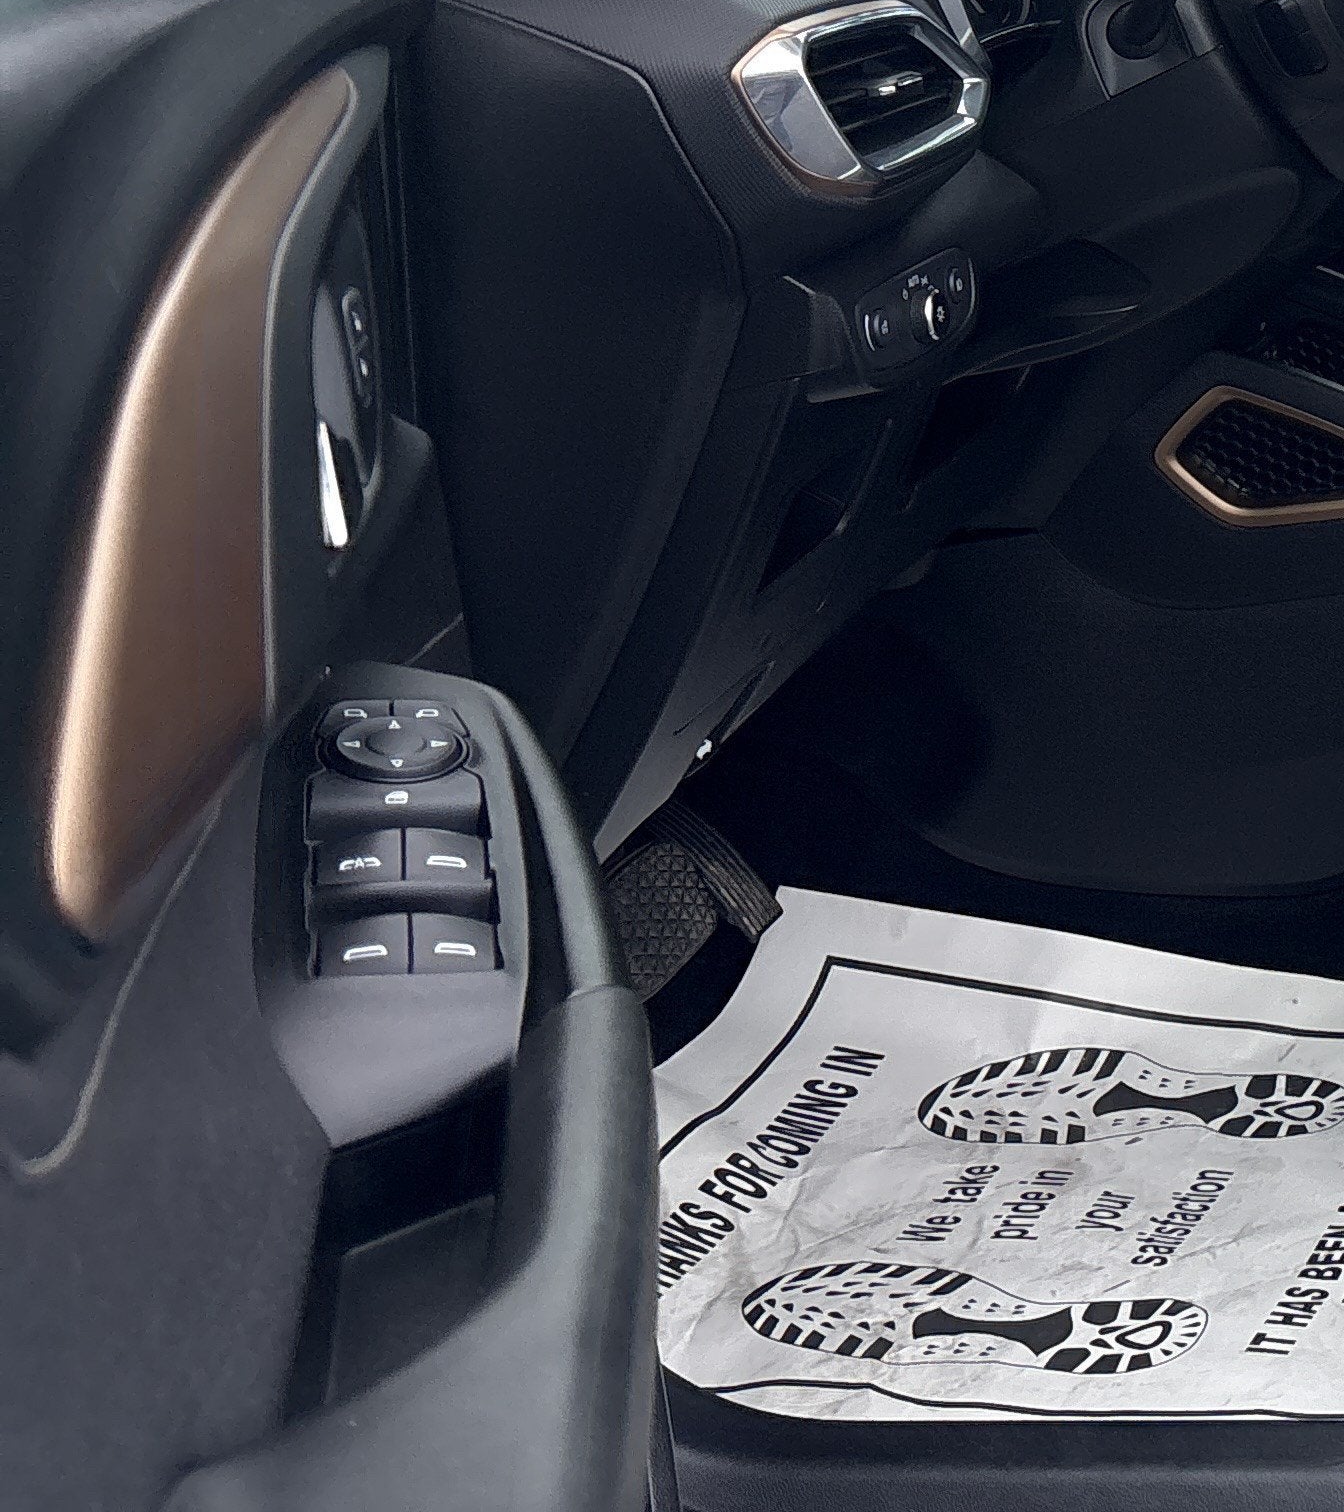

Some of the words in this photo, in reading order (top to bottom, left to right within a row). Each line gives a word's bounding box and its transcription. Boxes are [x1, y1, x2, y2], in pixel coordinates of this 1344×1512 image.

[657, 1202, 734, 1298] ANKS
[698, 1153, 785, 1213] FOR
[746, 1079, 858, 1169] COMING
[820, 1046, 885, 1076] IN
[1019, 1169, 1074, 1186] in
[896, 1214, 962, 1241] We
[933, 1165, 1000, 1203] take
[990, 1191, 1056, 1241] pride
[1075, 1190, 1135, 1231] your
[1131, 1169, 1234, 1267] satisfaction
[1264, 1287, 1329, 1327] HAS
[1244, 1332, 1297, 1355] IT
